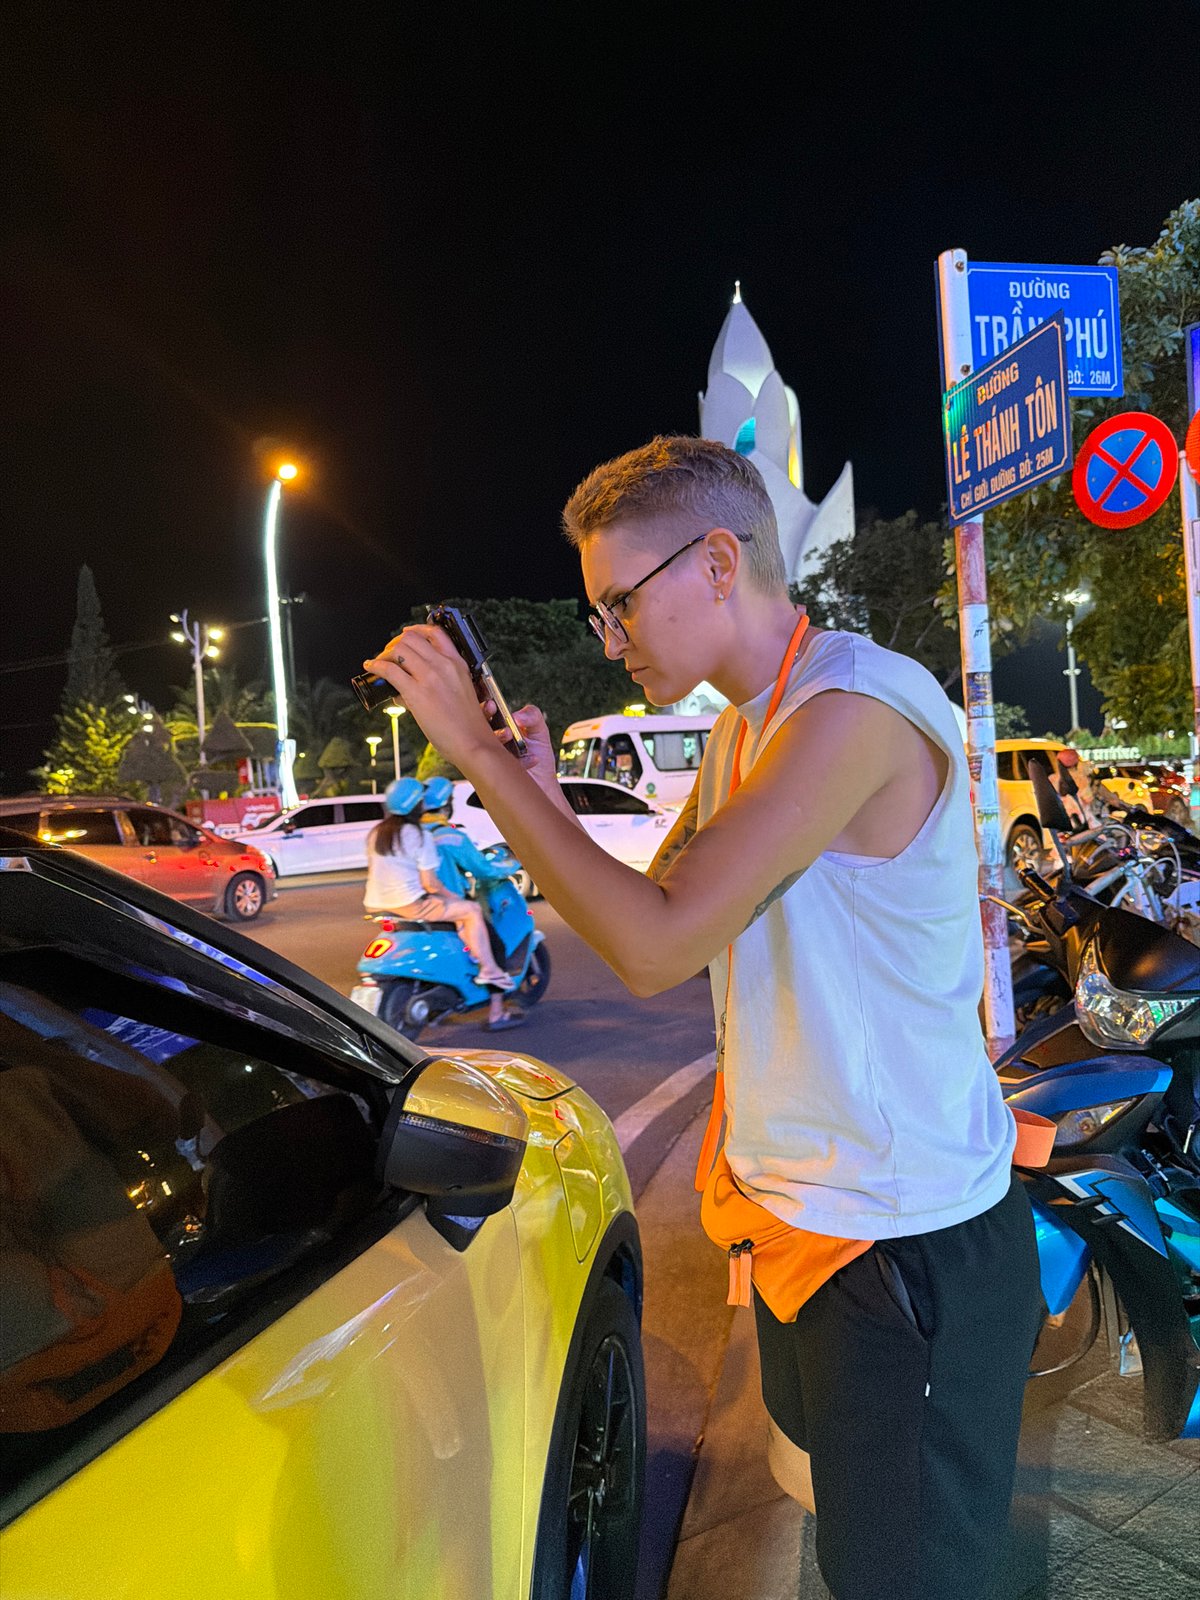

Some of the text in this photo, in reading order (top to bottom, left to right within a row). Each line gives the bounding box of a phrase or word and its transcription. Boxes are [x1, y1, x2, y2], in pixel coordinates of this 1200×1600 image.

[1008, 277, 1071, 299] ĐƯỜNG
[974, 300, 1044, 357] TRẦ
[976, 362, 1019, 406] ĐƯỜNG
[1090, 370, 1111, 385] 26M
[952, 375, 1058, 485] LÊ THÁNH TÔN
[1035, 446, 1054, 471] 25M
